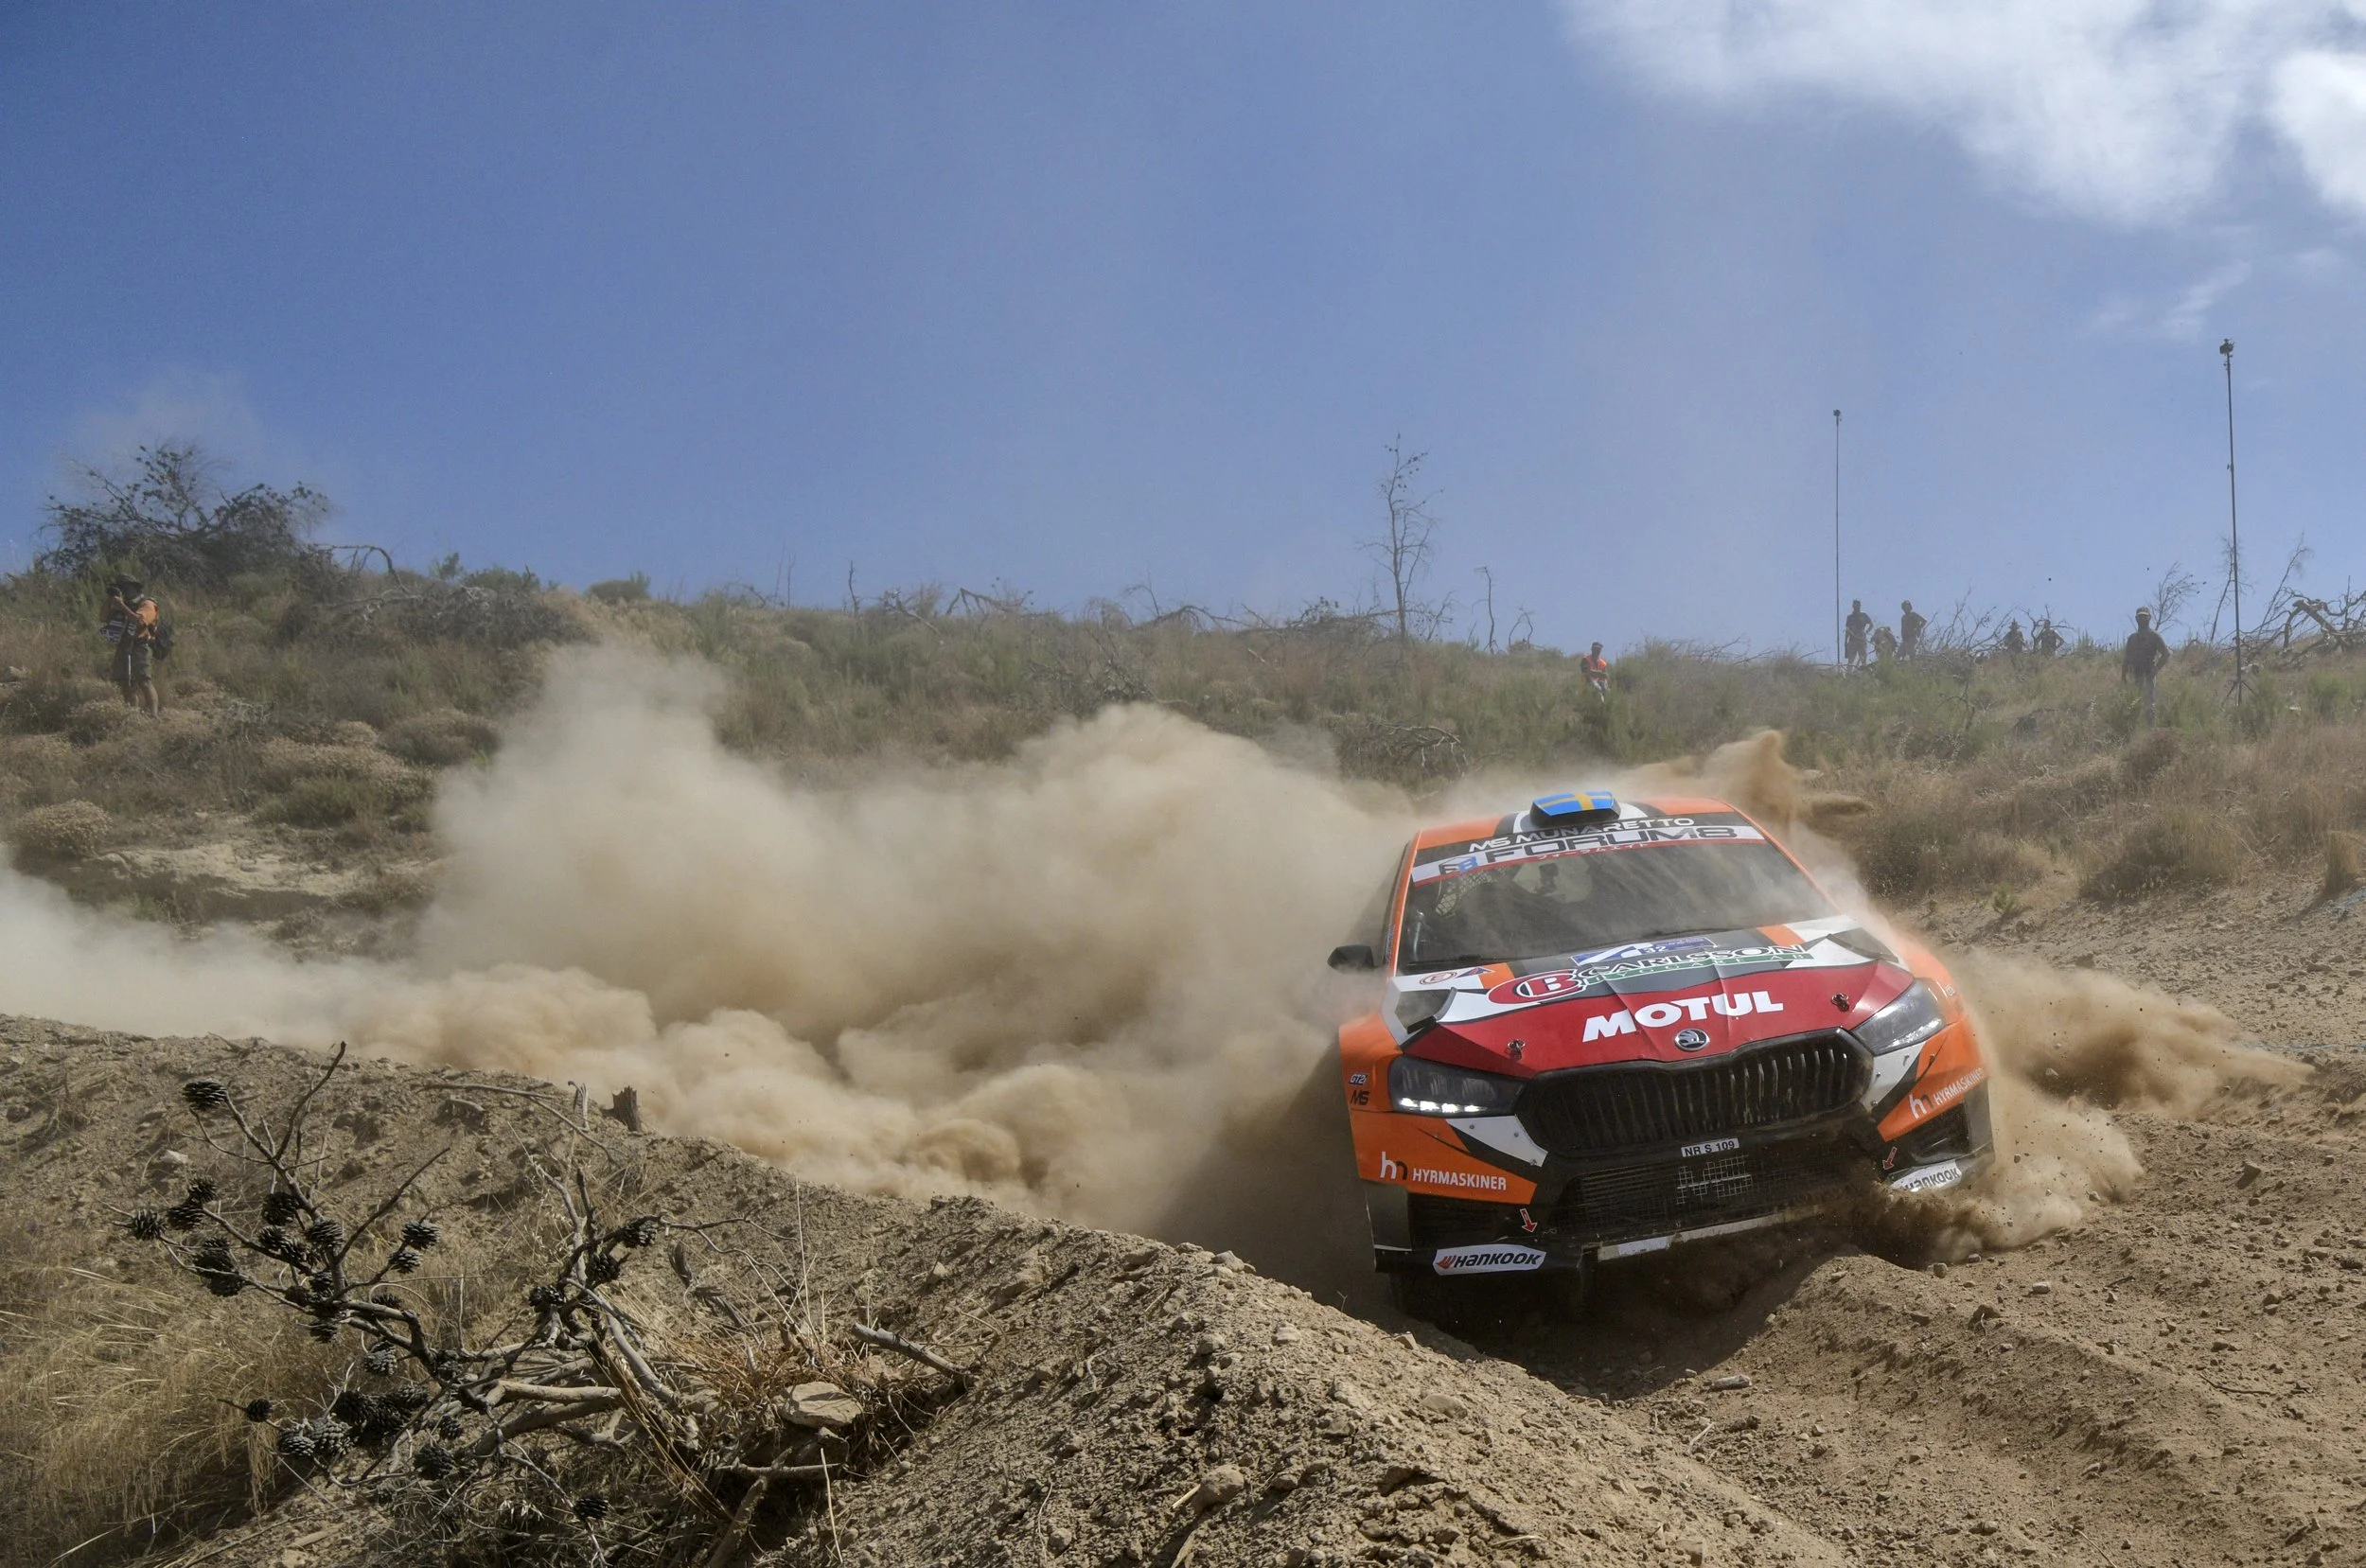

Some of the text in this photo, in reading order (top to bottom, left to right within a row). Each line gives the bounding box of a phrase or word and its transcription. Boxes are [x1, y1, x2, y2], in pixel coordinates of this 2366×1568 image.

[1469, 818, 1695, 853] MS MUNARETTO
[1486, 827, 1738, 864] FORUM8
[1578, 943, 1803, 978] CARLSSON
[1582, 991, 1784, 1043] MOTUL
[1684, 1140, 1735, 1156] NR S 109
[1412, 1168, 1508, 1190] HYRMASKINER
